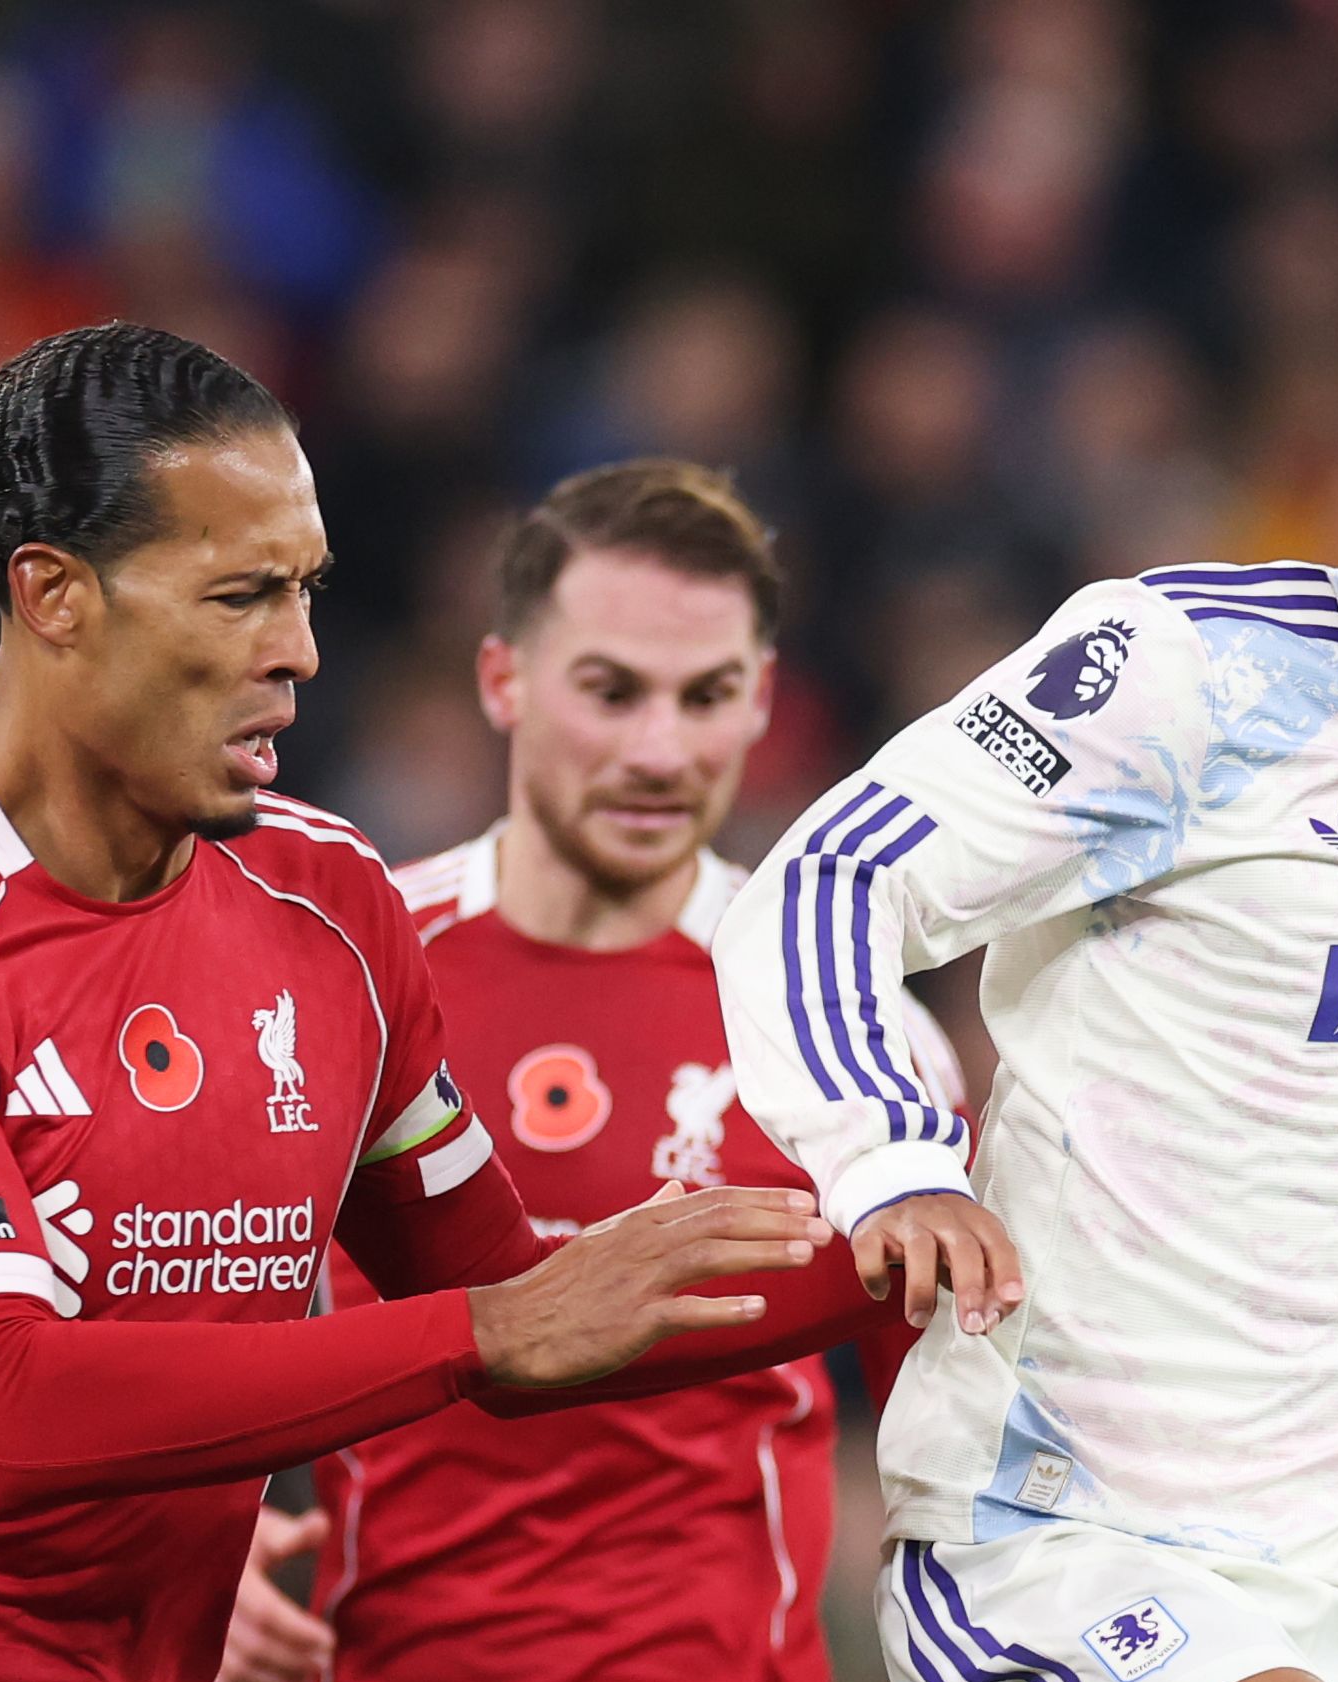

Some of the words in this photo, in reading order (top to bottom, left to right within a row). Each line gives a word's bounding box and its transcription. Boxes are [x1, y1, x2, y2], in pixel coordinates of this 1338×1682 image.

[973, 691, 1003, 724] No
[997, 715, 1057, 774] room
[981, 730, 1051, 798] racism
[111, 1196, 313, 1250] standard
[106, 1246, 317, 1296] chartered
